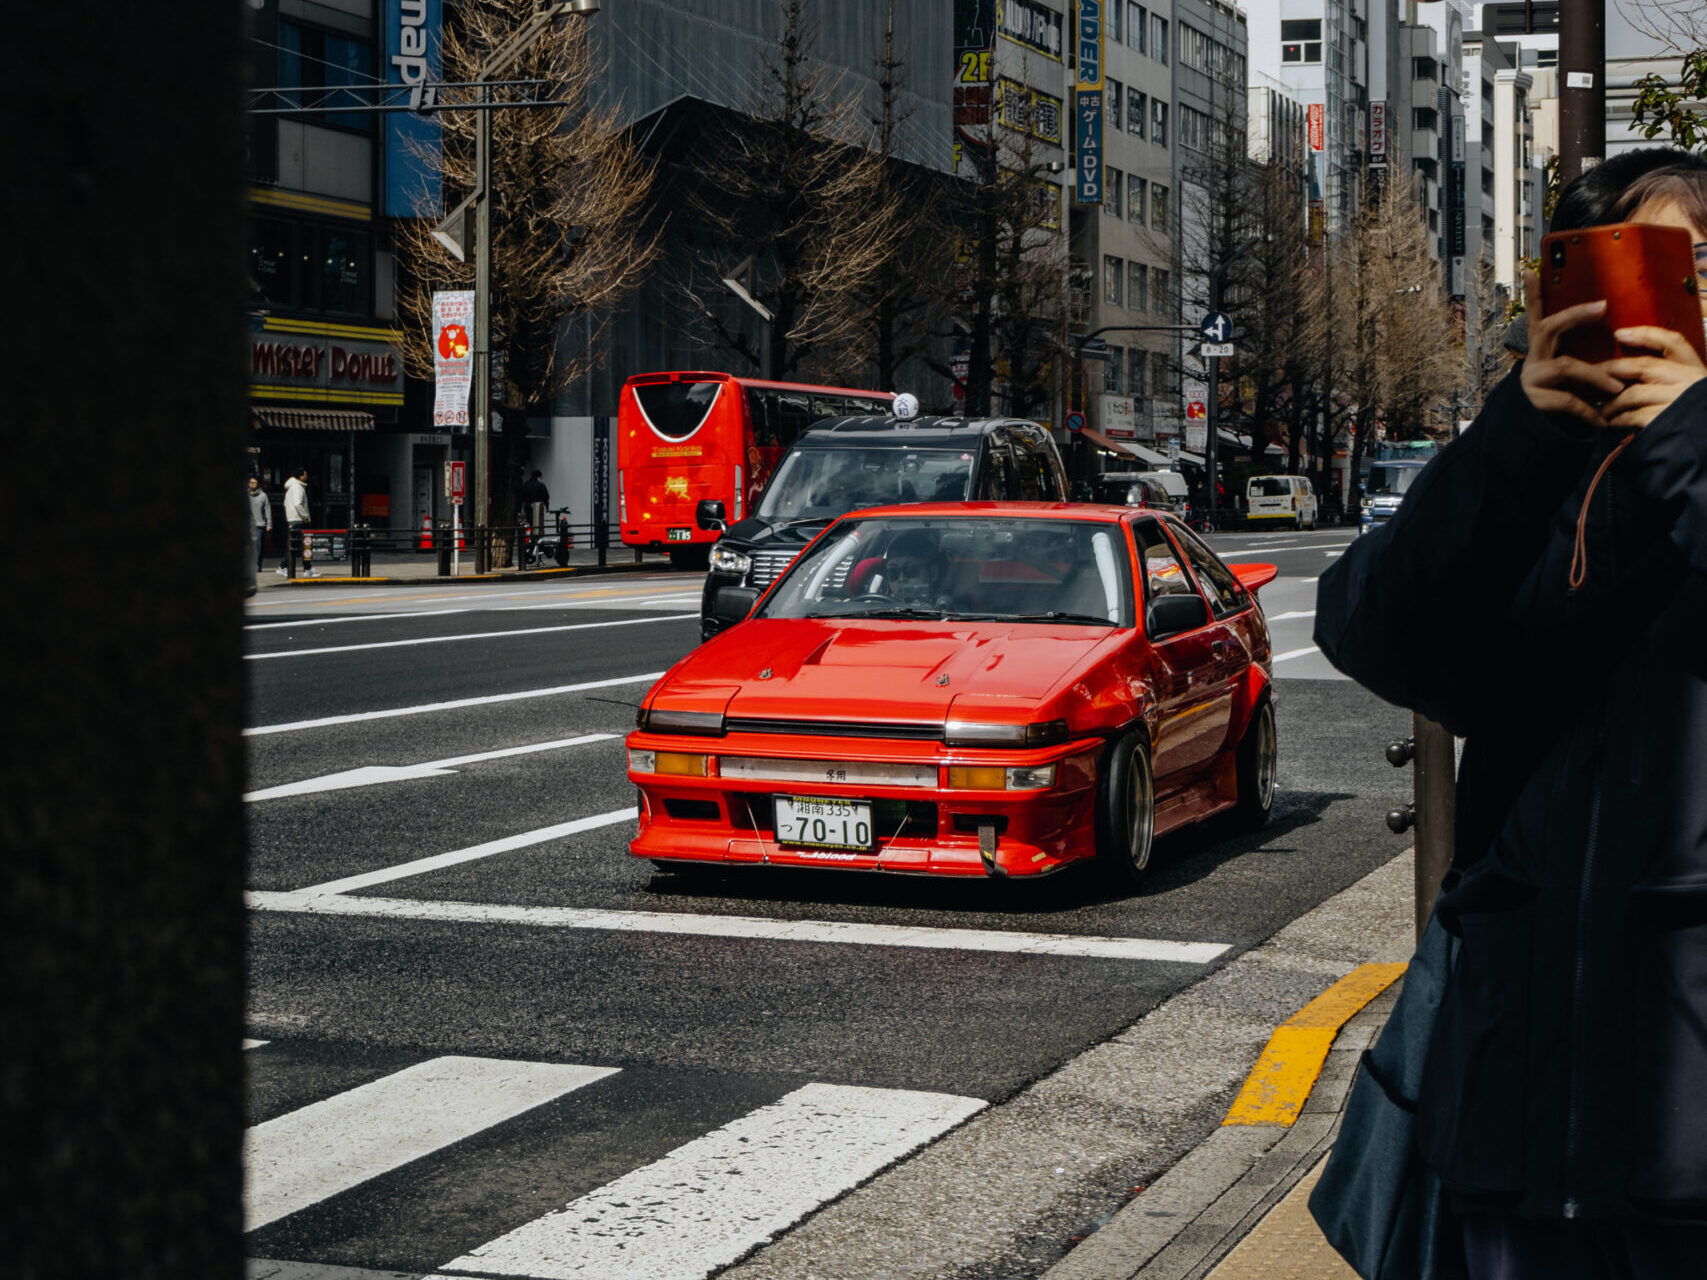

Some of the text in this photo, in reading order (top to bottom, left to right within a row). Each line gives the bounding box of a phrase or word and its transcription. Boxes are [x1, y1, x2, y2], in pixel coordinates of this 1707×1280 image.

[1080, 95, 1101, 107] 中古
[329, 346, 398, 383] Donut
[826, 804, 851, 817] 335
[780, 816, 869, 845] つ 70-10
